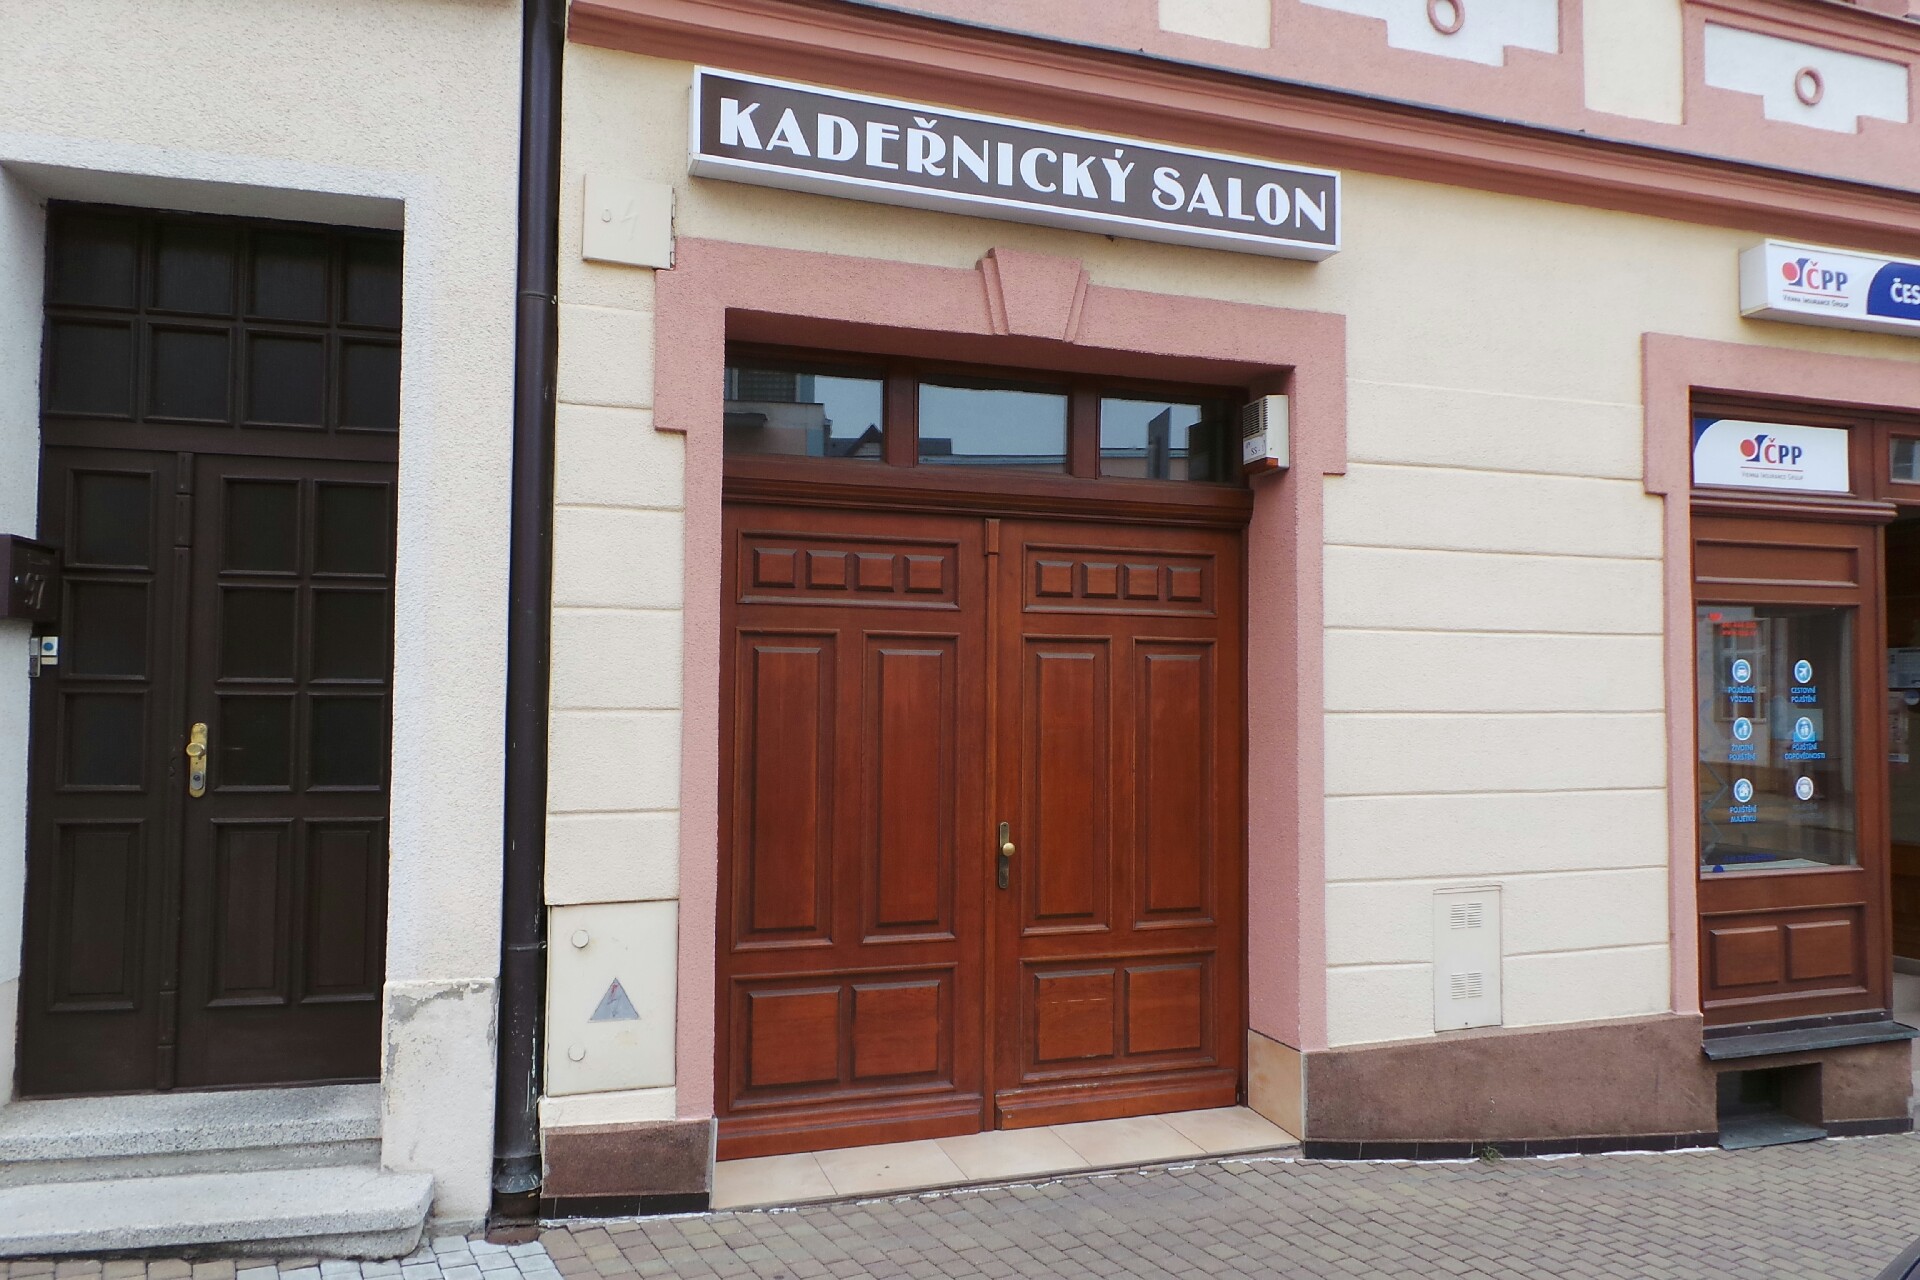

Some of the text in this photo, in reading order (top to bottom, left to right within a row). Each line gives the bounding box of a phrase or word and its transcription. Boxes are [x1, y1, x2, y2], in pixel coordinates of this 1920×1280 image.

[719, 97, 1326, 231] KADEŘNICKÝ SALON
[1806, 261, 1849, 292] ČPP
[1764, 438, 1803, 465] ČPP
[1791, 686, 1816, 694] CESTOVNÍ
[1729, 805, 1757, 814] POJIŠTĚNÍ
